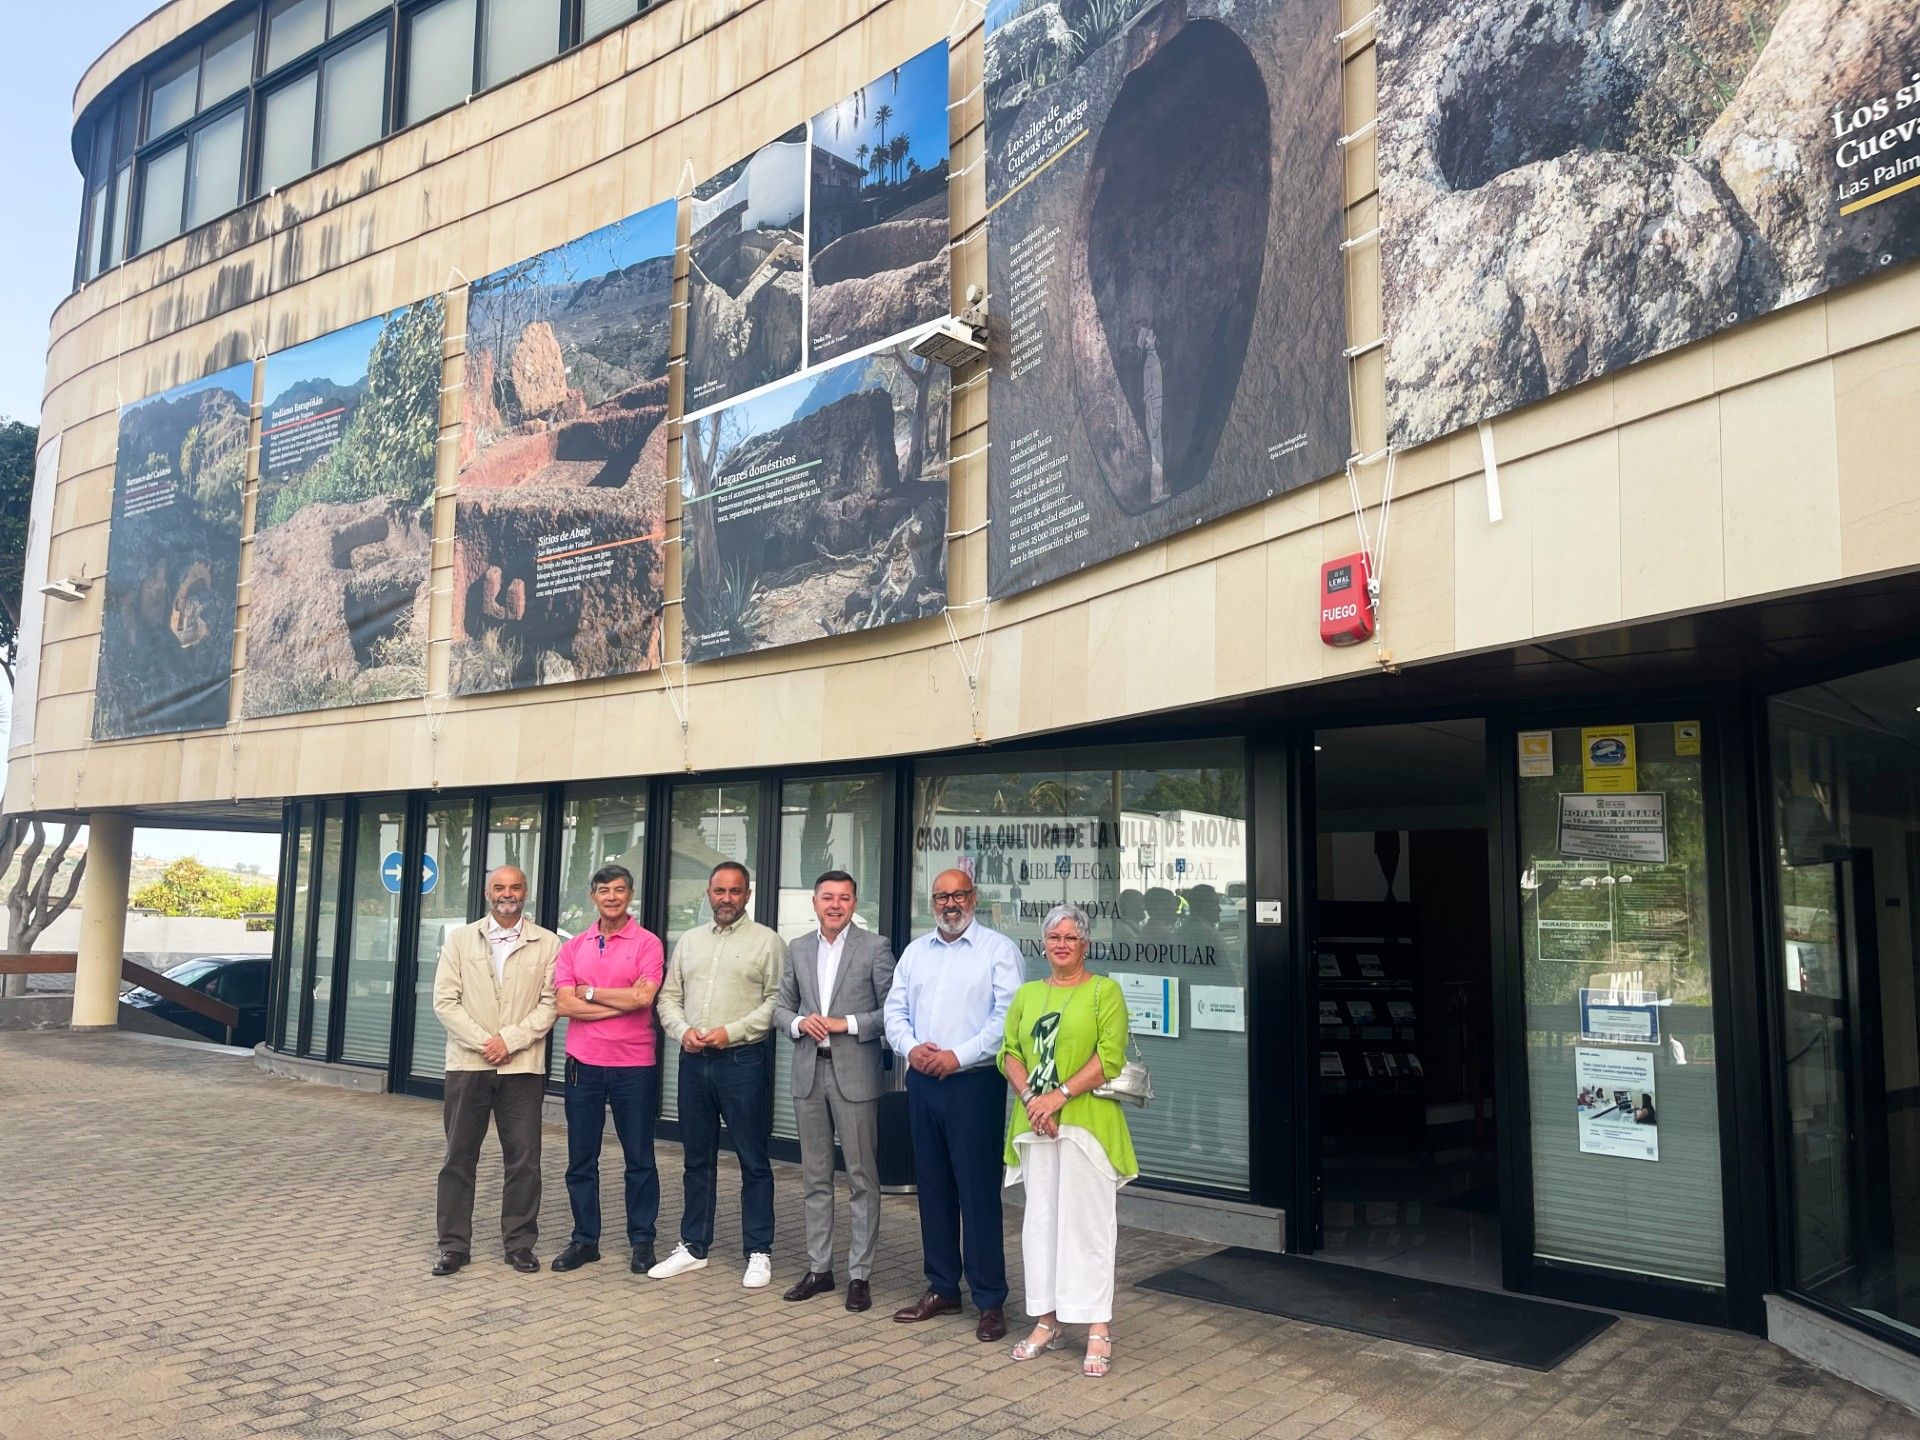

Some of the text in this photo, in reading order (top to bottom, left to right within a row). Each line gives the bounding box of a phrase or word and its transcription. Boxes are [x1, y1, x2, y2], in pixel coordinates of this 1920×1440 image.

[1008, 105, 1060, 157] Los silos de
[1831, 97, 1890, 140] Los
[1008, 100, 1088, 172] Cuevas de Ortega
[1836, 117, 1920, 168] Cuev
[1009, 123, 1083, 188] Las Palmas de Gran Canaria
[1839, 154, 1920, 200] Las Palm
[719, 454, 796, 487] Lagares domésticos
[538, 526, 591, 546] Sitios de Abajo
[1323, 604, 1356, 622] FUEGO
[1564, 809, 1662, 818] HORARIO VERANO
[916, 819, 1240, 850] CASA DE LA CULTURA DE LA VILLA DE MOYA
[1020, 862, 1217, 880] BIBLIOTECA MUNICIPAL
[1019, 939, 1216, 966] UNIDAD POPULAR
